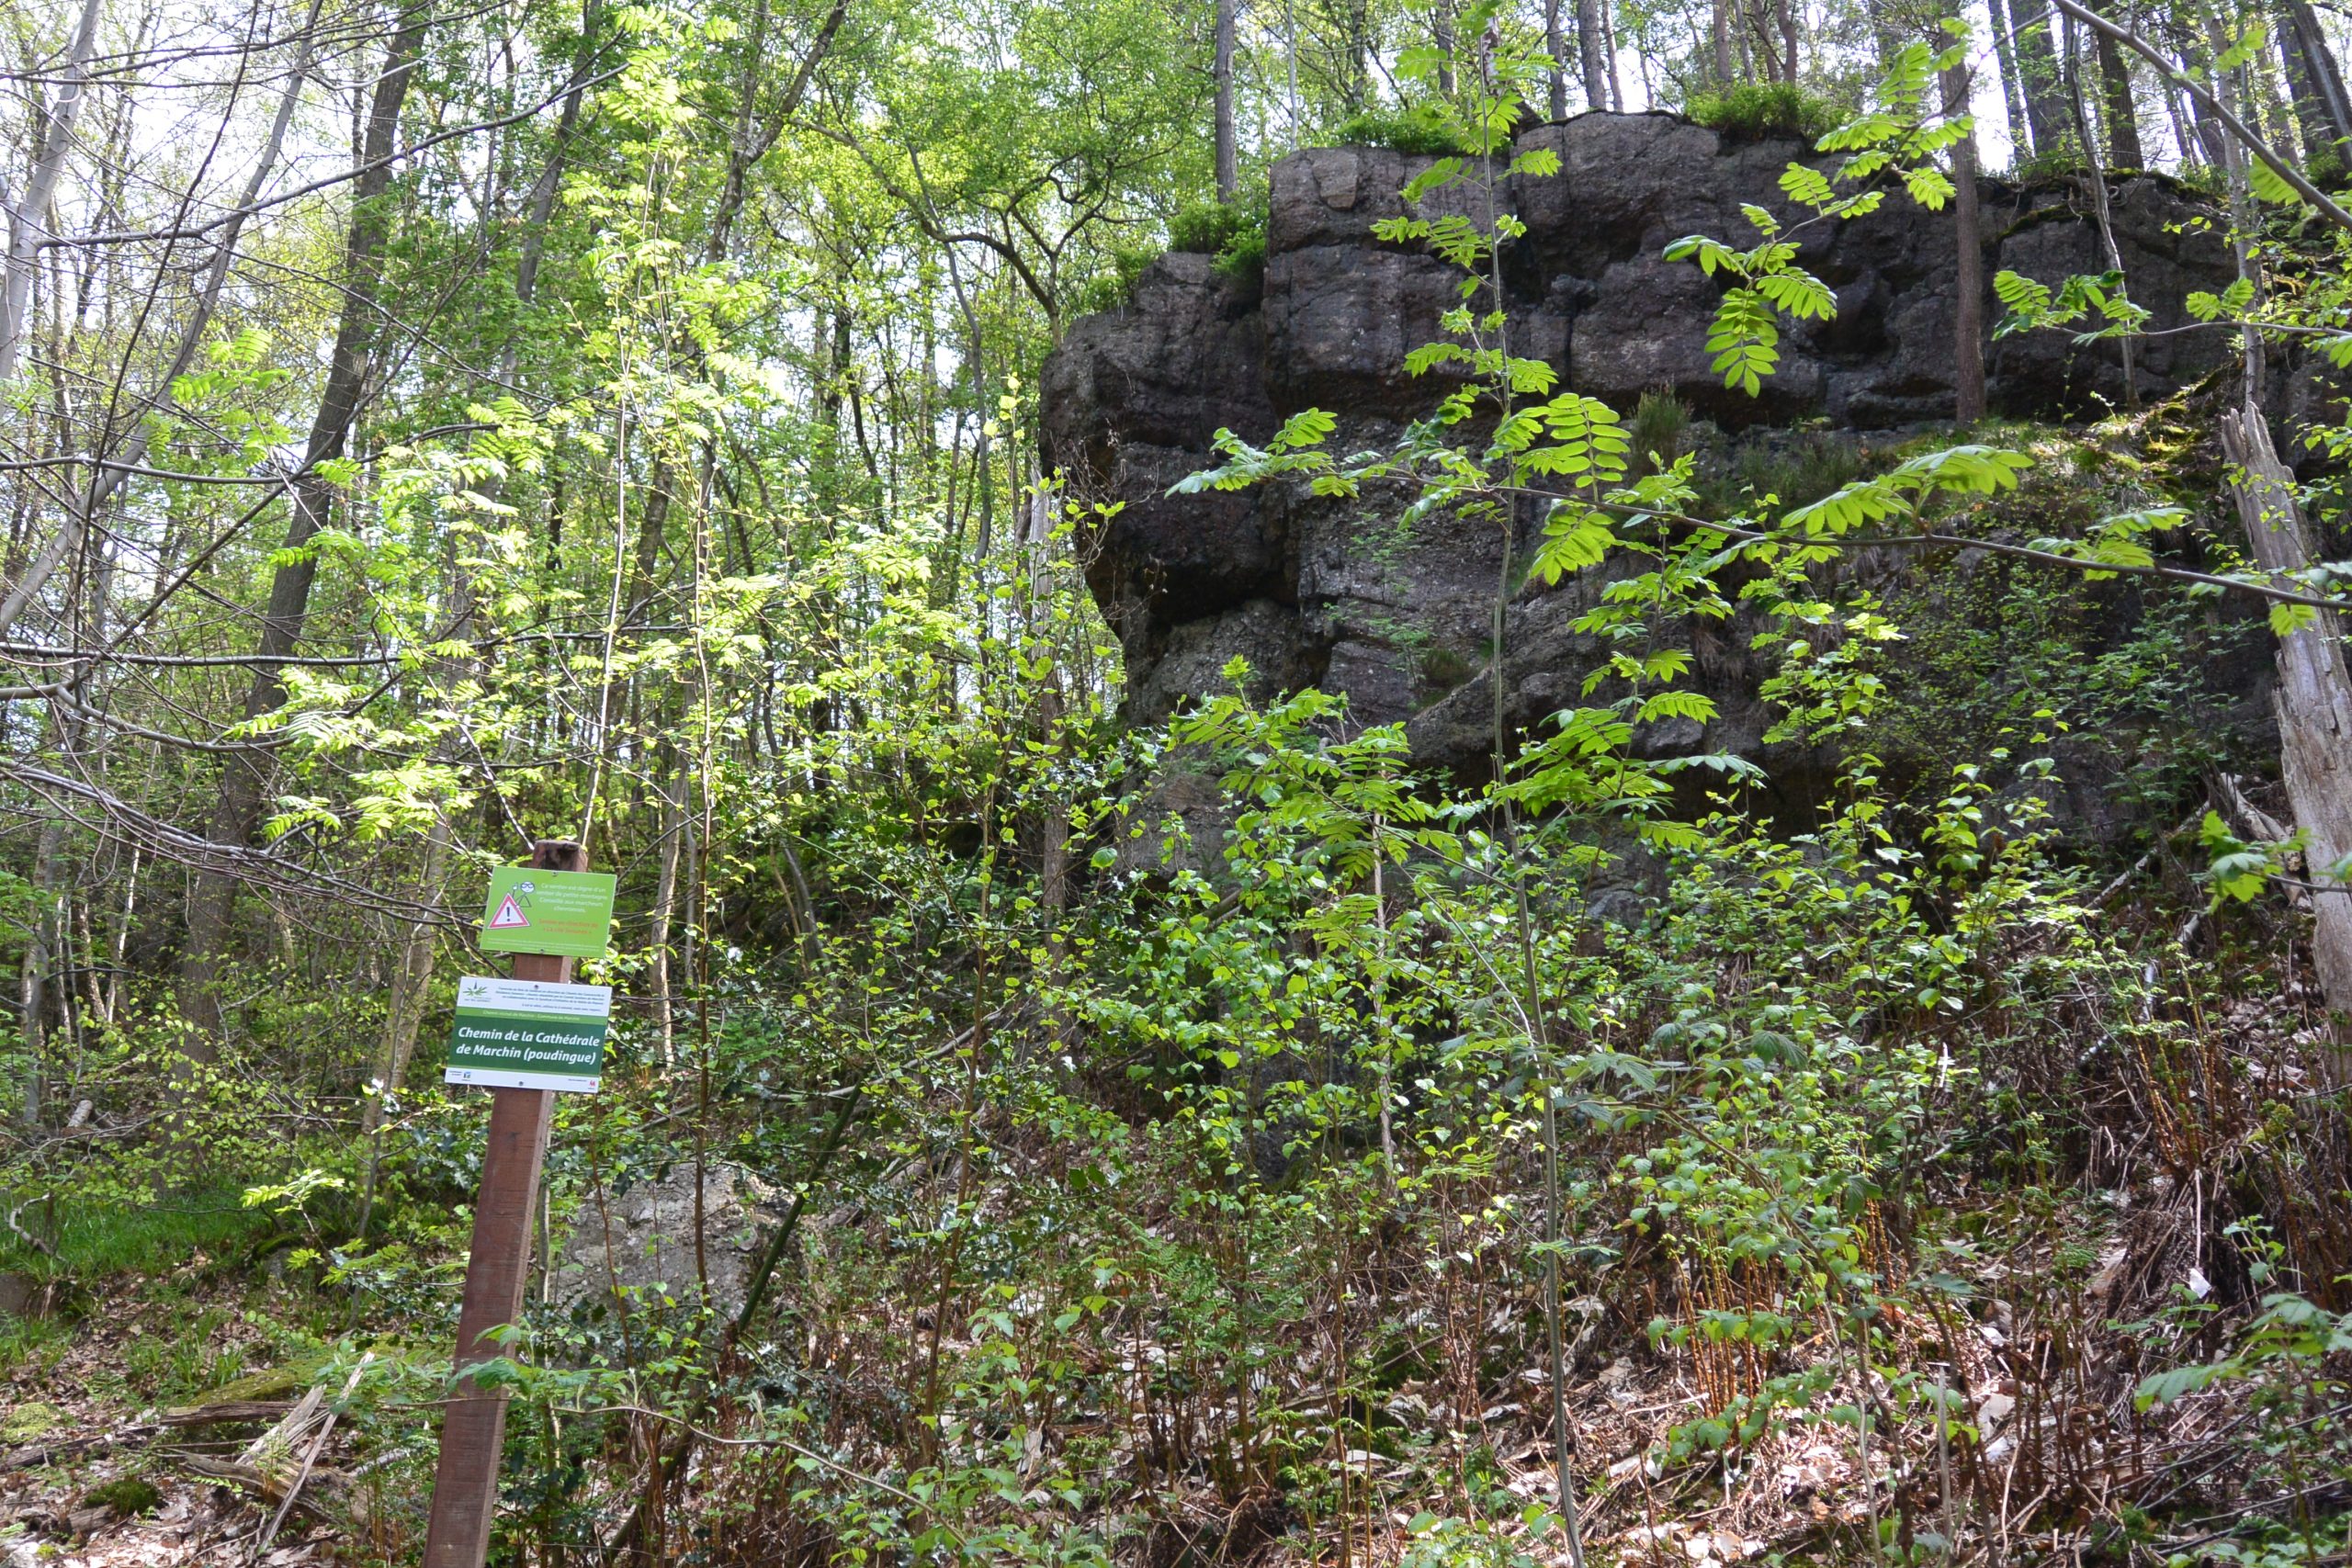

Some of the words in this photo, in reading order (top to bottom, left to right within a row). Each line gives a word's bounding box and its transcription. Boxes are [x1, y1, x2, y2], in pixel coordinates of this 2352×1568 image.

[458, 1026, 503, 1040] Chemin
[504, 1030, 519, 1041] de
[521, 1031, 534, 1043] la
[536, 1032, 600, 1046] Cathédrale
[456, 1043, 471, 1055] de
[472, 1044, 522, 1058] Marchin
[523, 1047, 596, 1066] (poudingue)
